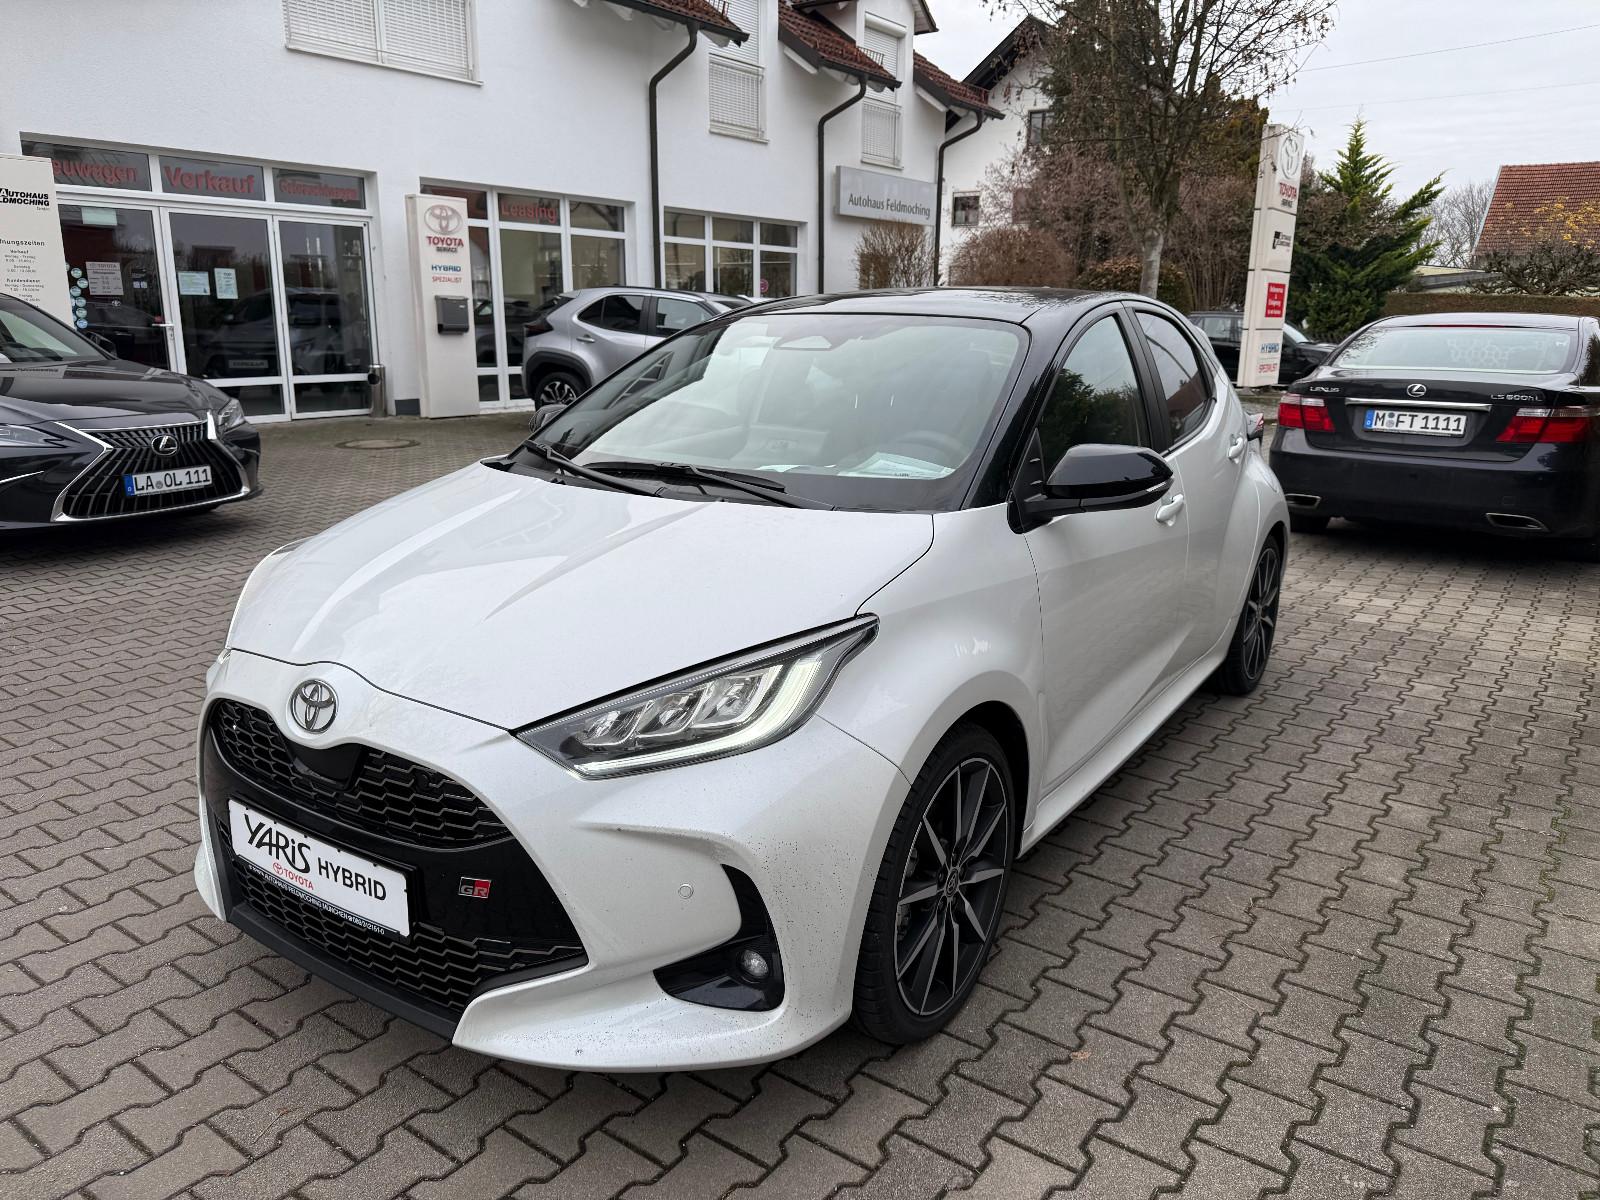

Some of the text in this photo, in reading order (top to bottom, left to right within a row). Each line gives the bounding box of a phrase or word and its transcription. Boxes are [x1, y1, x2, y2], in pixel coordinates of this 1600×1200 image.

[52, 159, 138, 184] euwagen
[163, 165, 256, 193] Verkauf
[501, 201, 558, 224] Leasing
[848, 193, 931, 220] Autohaus Feldmoching
[426, 236, 464, 247] TOYOTA
[431, 264, 462, 272] HYBRID
[432, 275, 463, 283] SPEZIALIST
[1374, 411, 1463, 432] M FT 1111
[134, 468, 211, 492] LA OL 111
[284, 867, 315, 891] TOYOTA
[318, 856, 387, 901] HYBRID
[460, 885, 488, 897] GR
